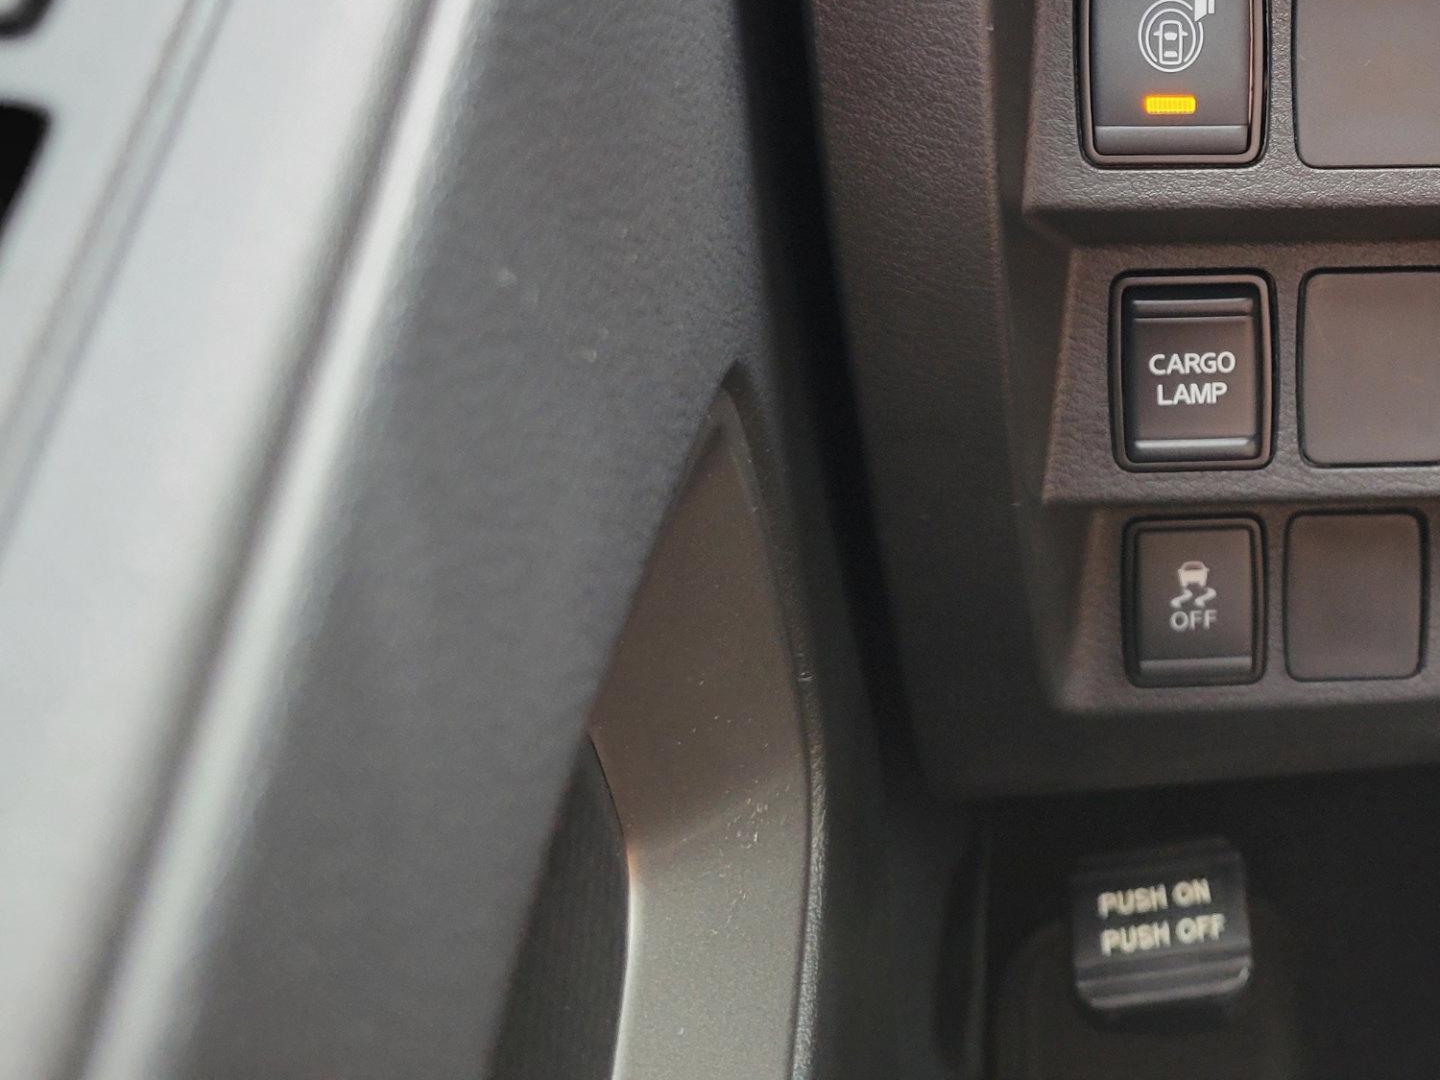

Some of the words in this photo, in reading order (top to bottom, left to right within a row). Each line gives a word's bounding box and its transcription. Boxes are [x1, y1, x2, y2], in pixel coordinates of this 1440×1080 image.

[1148, 351, 1236, 376] CARGO
[1156, 381, 1228, 406] LAMP
[1169, 609, 1218, 632] OFF
[1097, 886, 1168, 919] PUSH
[1171, 877, 1212, 907] ON
[1100, 923, 1170, 956] PUSH
[1176, 913, 1225, 945] OFF
